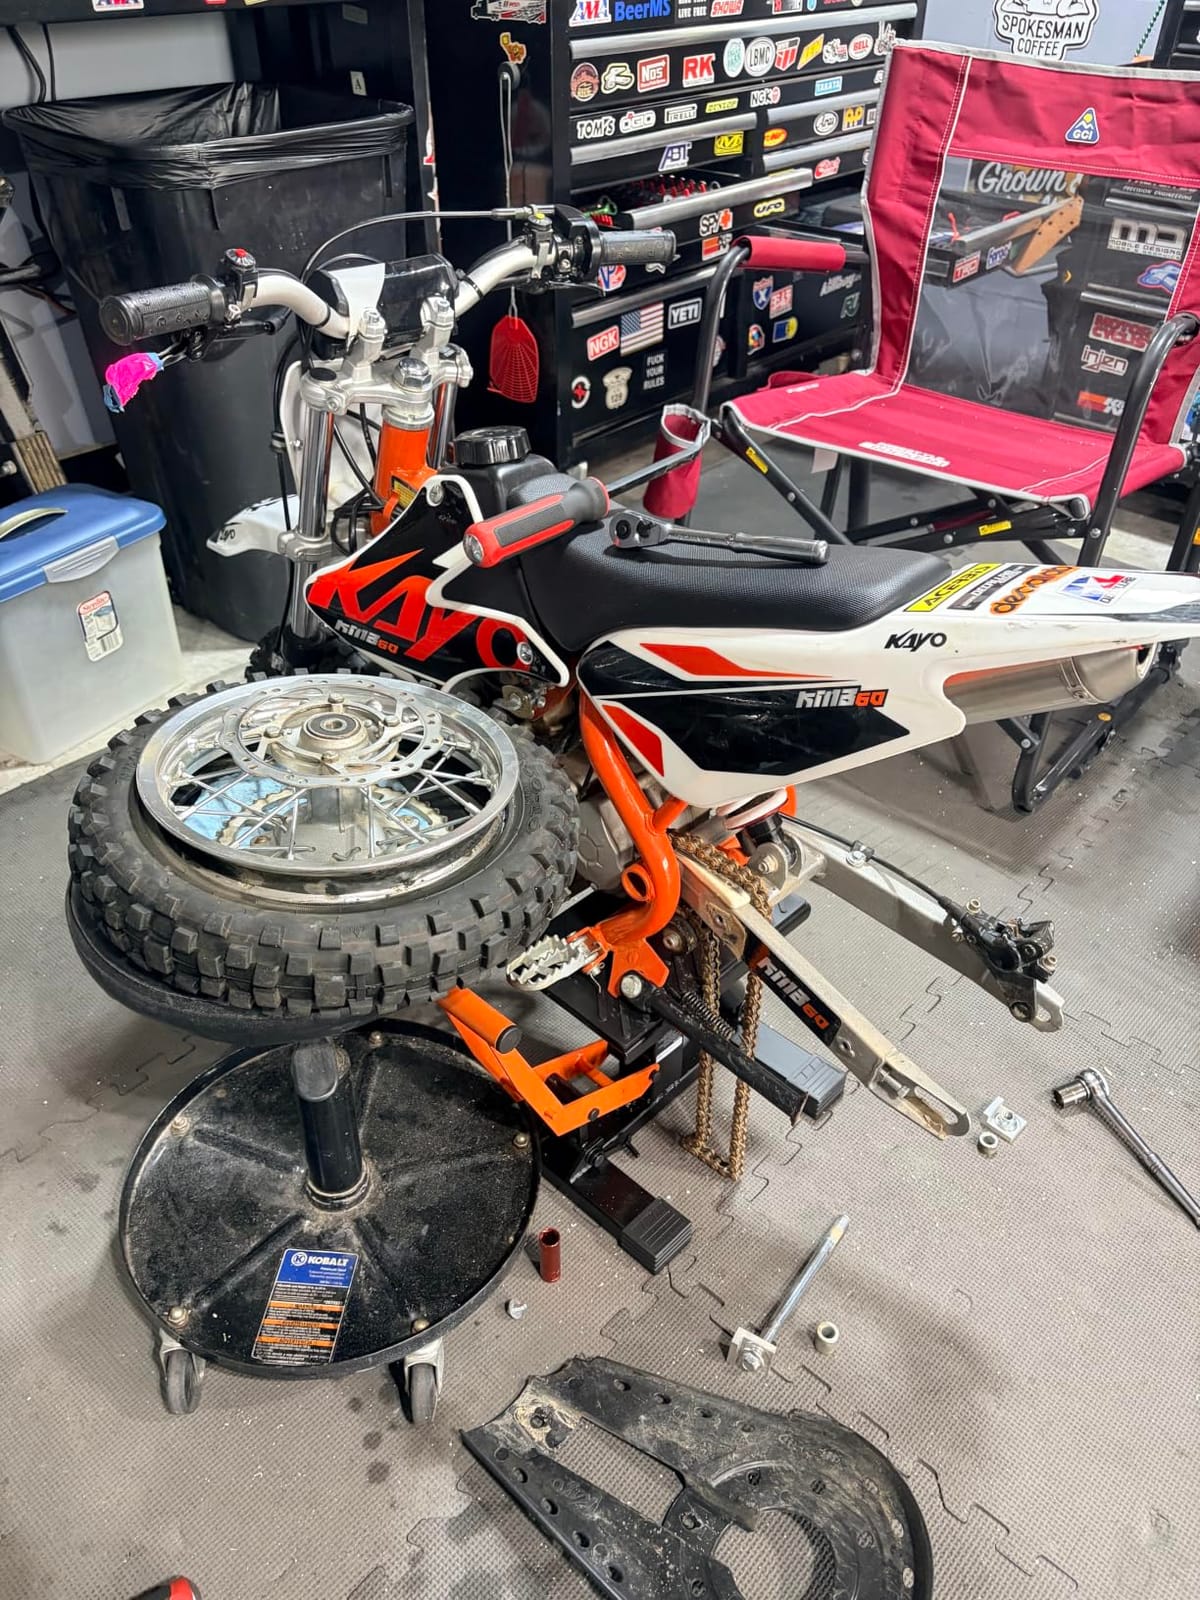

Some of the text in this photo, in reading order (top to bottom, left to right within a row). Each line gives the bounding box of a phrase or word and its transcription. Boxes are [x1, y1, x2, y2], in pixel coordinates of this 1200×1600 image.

[1002, 14, 1085, 39] SPOKESMAN
[853, 39, 869, 52] BELL
[1017, 38, 1060, 56] COFFEE
[750, 46, 770, 67] LBMC
[684, 55, 715, 80] RK
[751, 90, 772, 106] NGK
[666, 106, 696, 123] PIRELLI
[579, 118, 614, 138] TOM'S
[1072, 129, 1093, 140] GCI
[661, 144, 687, 169] ABT
[978, 161, 1067, 193] Grown
[756, 202, 782, 214] UFO
[671, 305, 699, 325] YETI
[590, 332, 618, 356] NGK
[923, 565, 991, 607] ACERBIS
[307, 549, 531, 668] KAYO
[884, 628, 947, 652] KAYO
[308, 1255, 348, 1267] KOBALT
